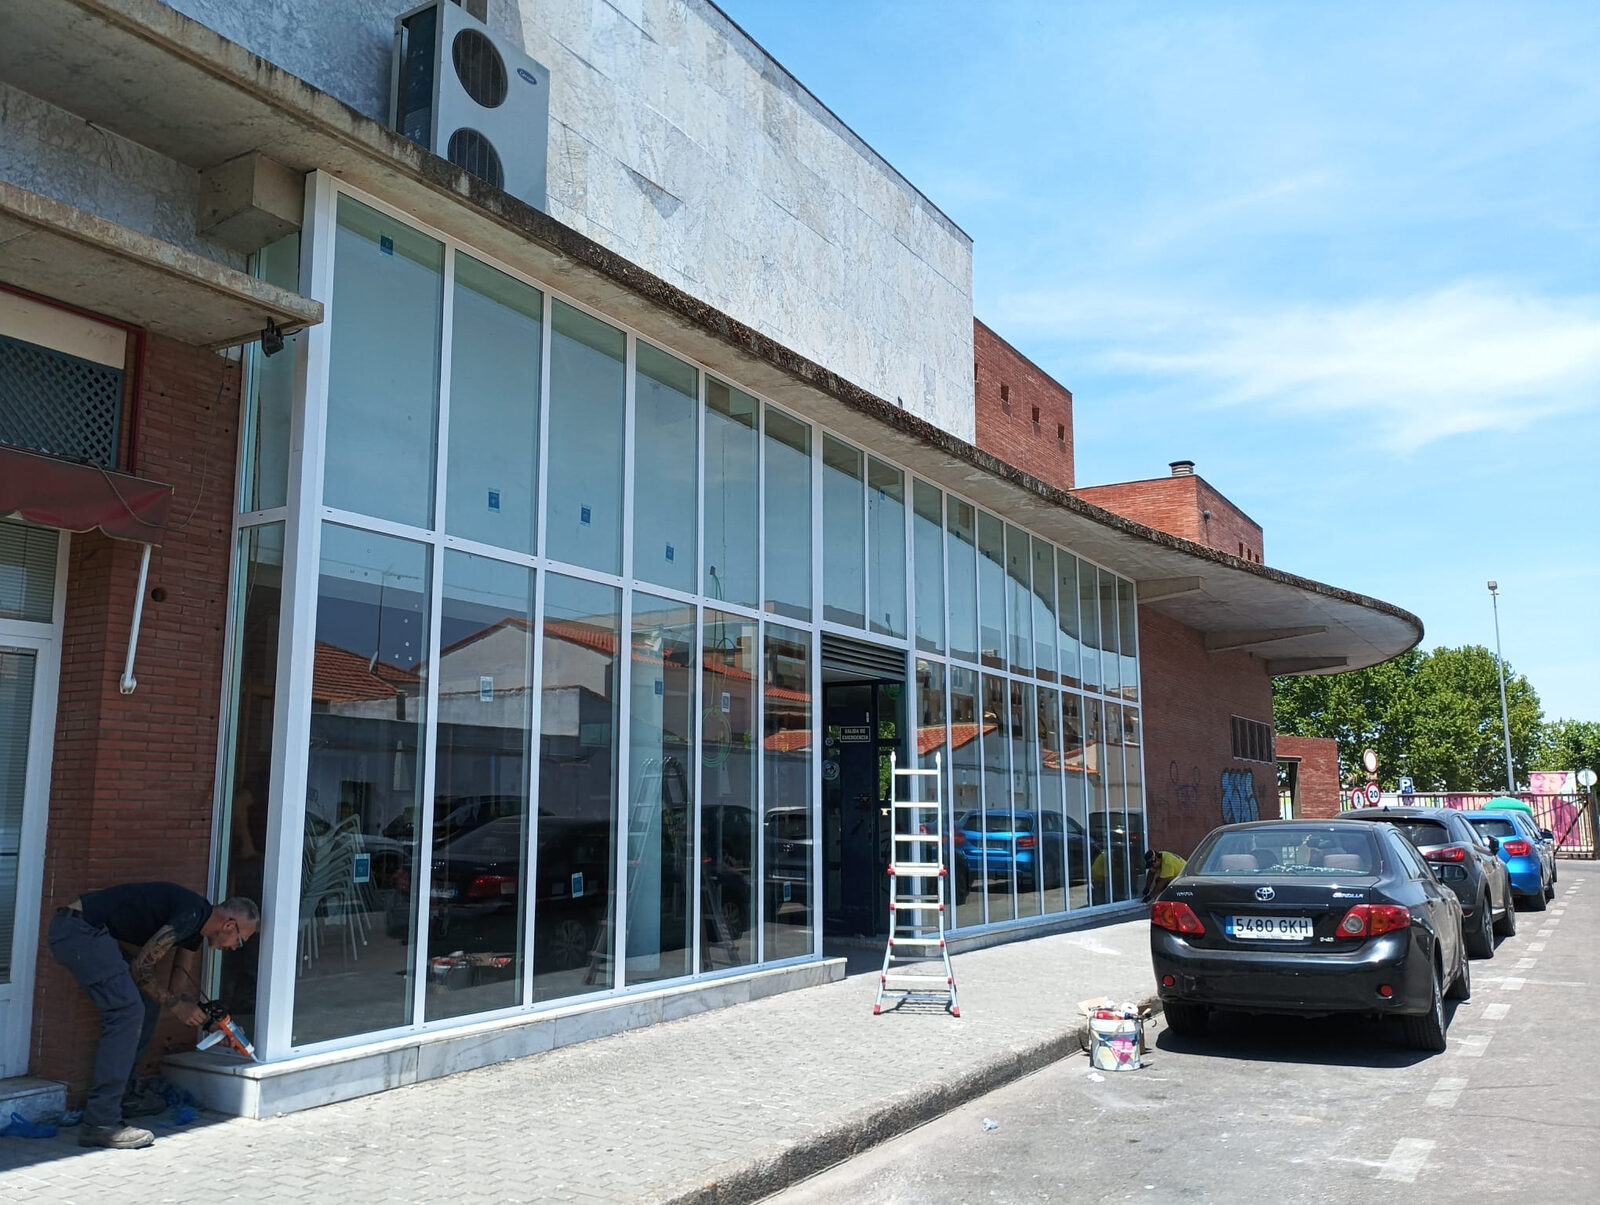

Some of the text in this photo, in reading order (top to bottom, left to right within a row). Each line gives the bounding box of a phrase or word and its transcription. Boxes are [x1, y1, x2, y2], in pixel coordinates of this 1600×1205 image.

[1401, 779, 1411, 791] P
[1370, 790, 1378, 798] 20
[1236, 918, 1274, 933] 5480
[1279, 919, 1308, 934] GKH
